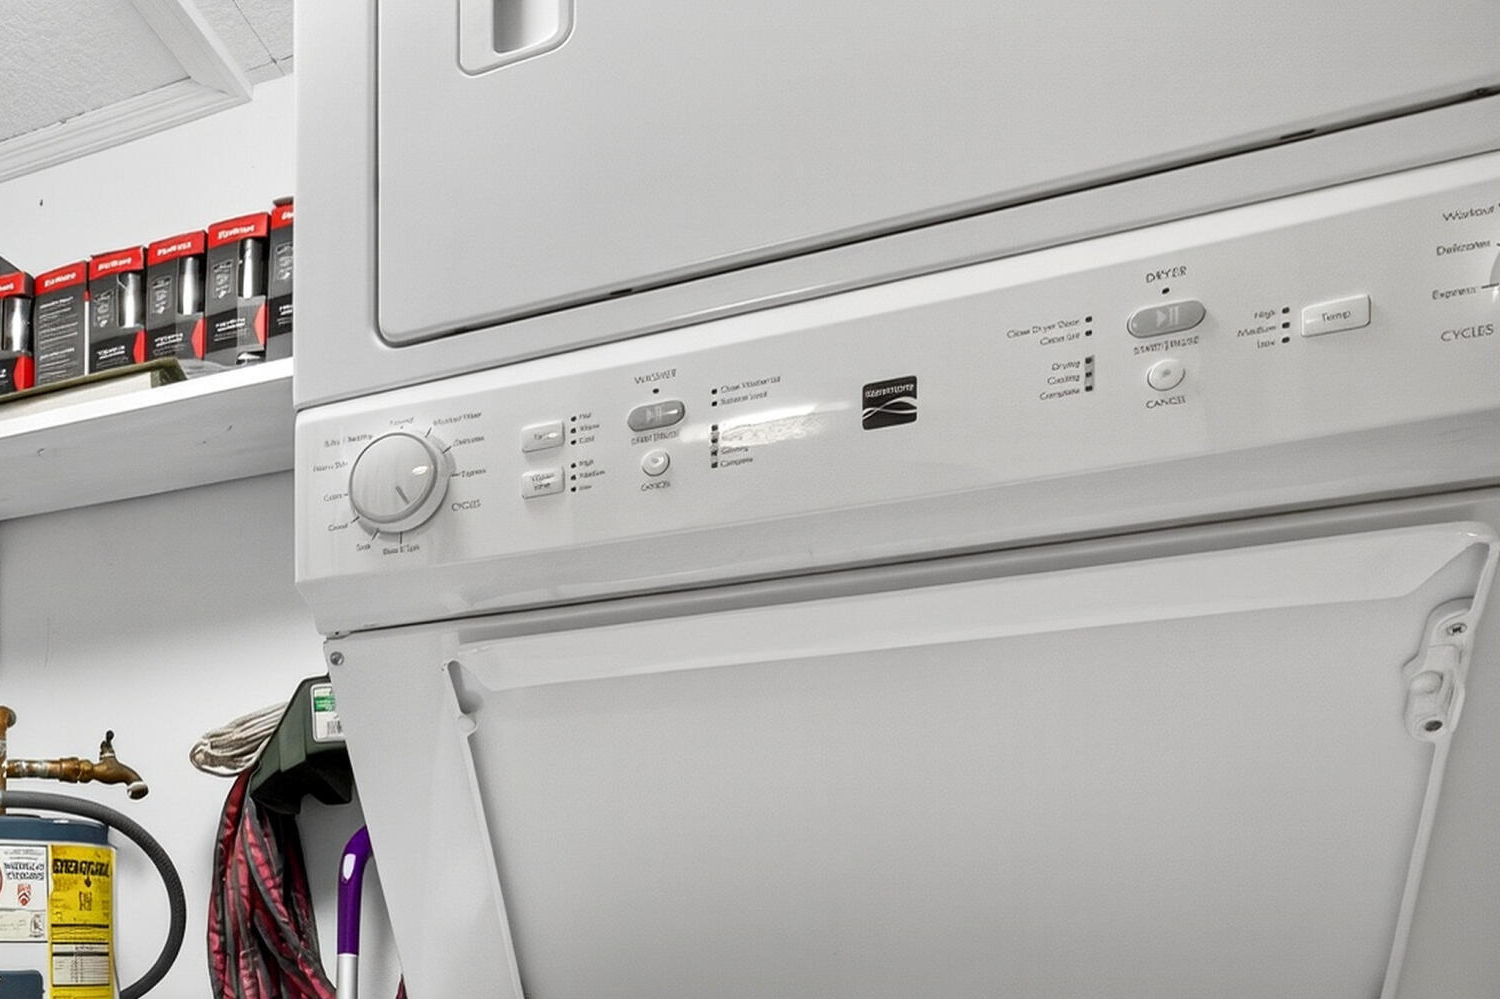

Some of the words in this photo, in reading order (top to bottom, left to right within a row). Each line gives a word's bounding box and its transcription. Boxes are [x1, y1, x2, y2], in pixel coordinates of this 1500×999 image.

[1145, 265, 1187, 283] DRYER
[1322, 309, 1352, 322] Temp
[1440, 324, 1495, 342] CYCLES
